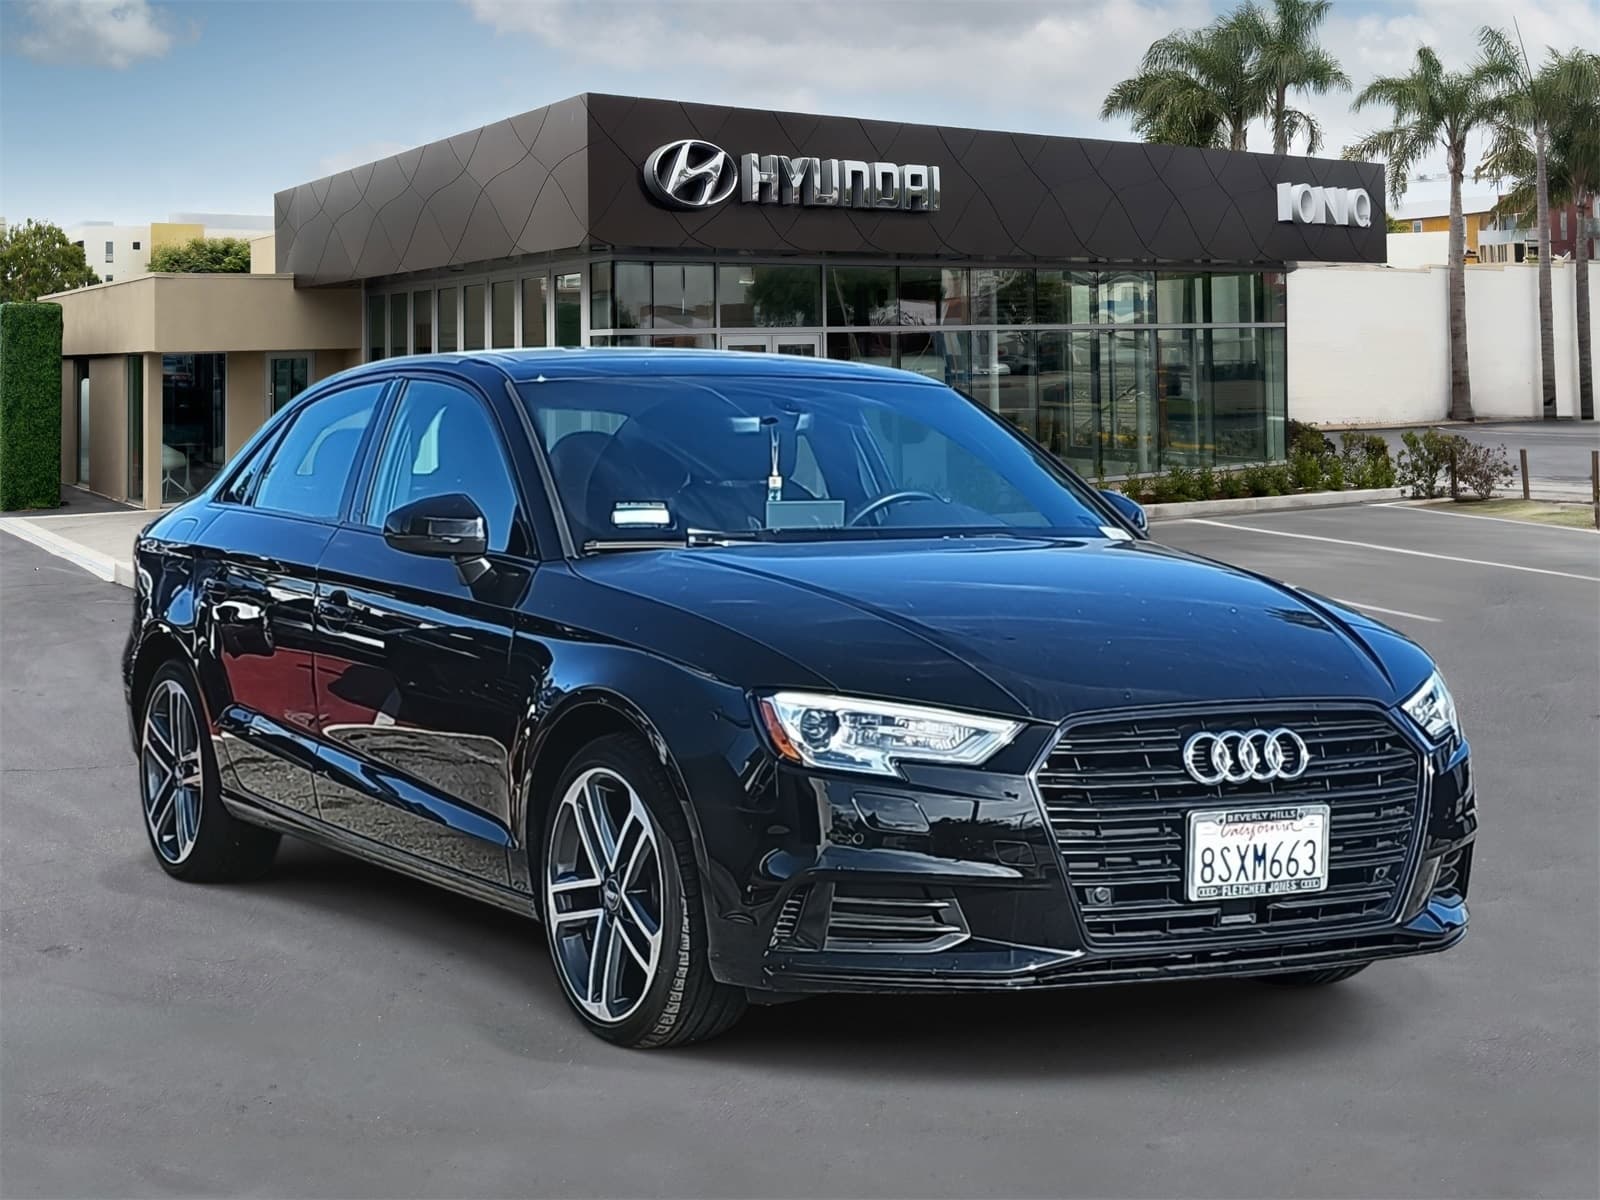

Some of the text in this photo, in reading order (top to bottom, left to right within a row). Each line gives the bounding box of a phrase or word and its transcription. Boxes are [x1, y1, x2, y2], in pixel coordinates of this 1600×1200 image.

[741, 153, 940, 211] HYUNDAI
[1227, 810, 1296, 822] BEVERLY HILLS
[1221, 822, 1302, 840] California
[1201, 840, 1316, 883] 8SXM663
[1222, 881, 1297, 896] FLETCHER JONES
